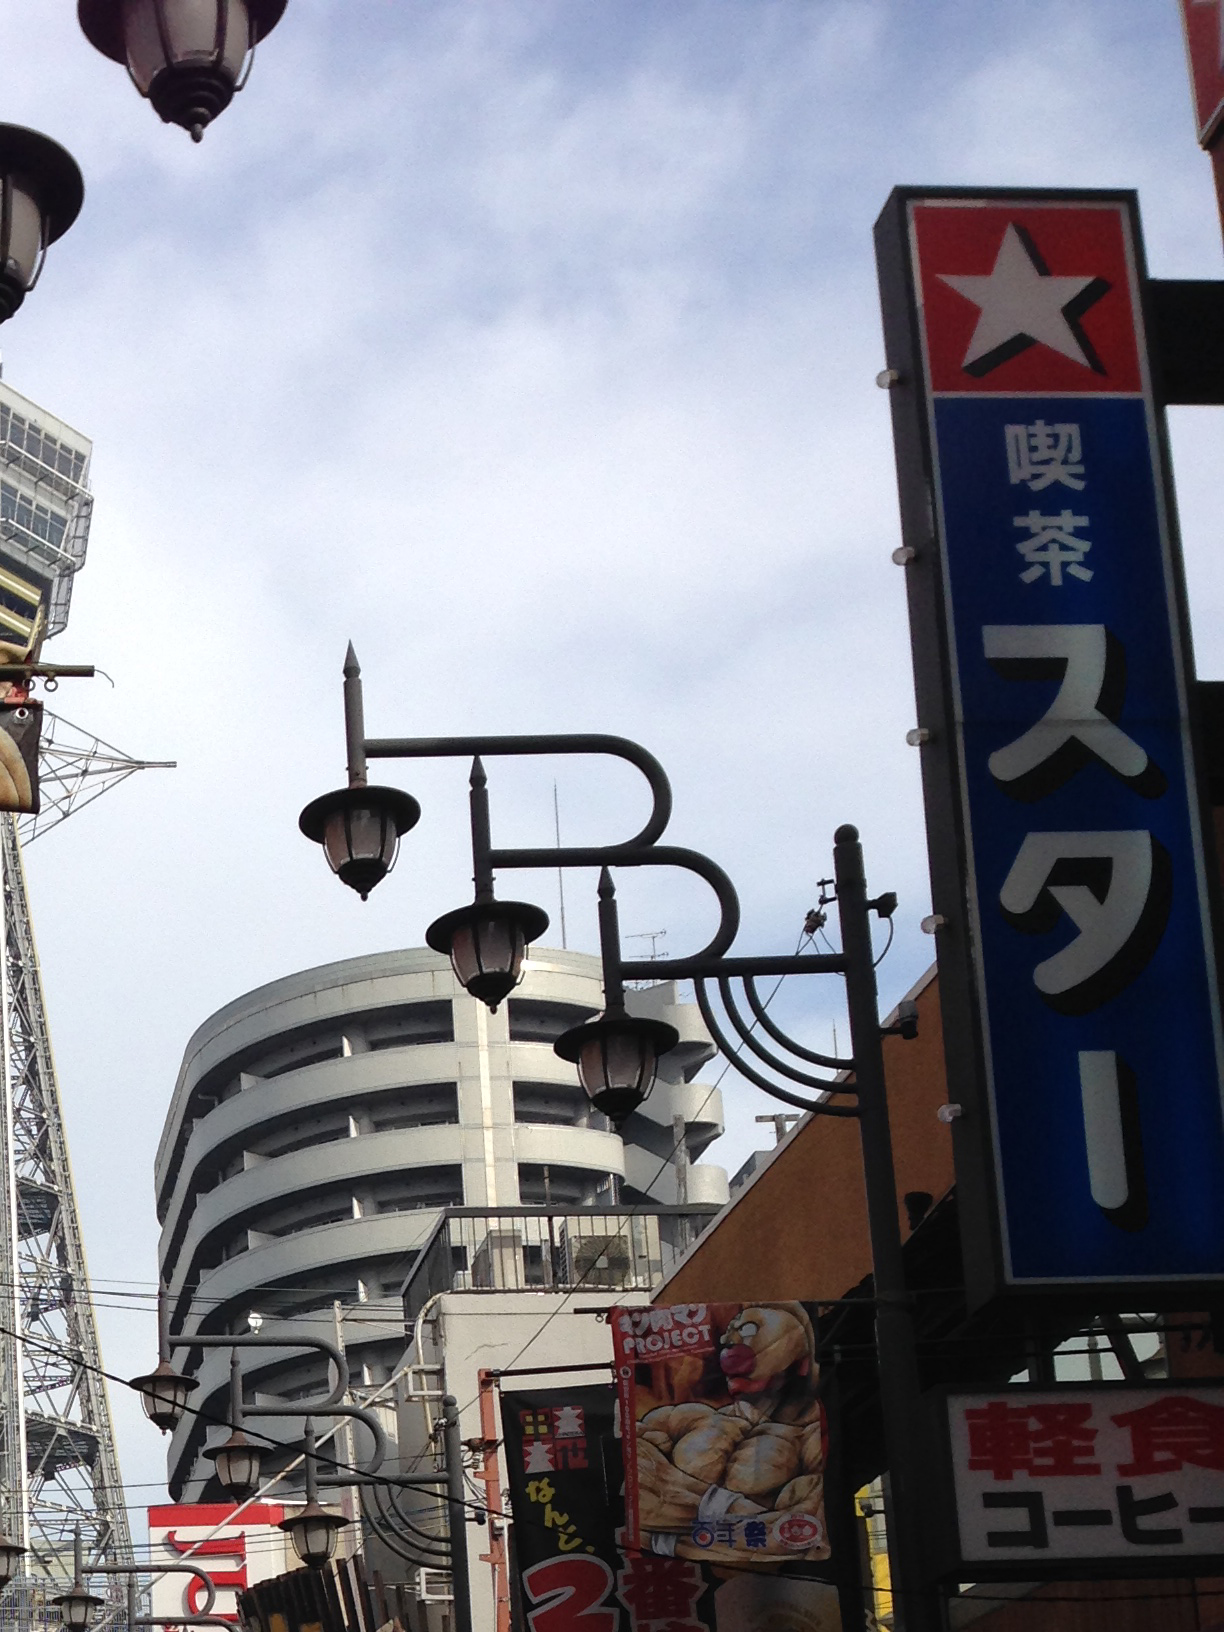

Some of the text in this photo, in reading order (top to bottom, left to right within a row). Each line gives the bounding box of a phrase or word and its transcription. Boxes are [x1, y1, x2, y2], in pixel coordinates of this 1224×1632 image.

[1005, 420, 1095, 586] 喫茶
[981, 623, 1166, 1220] スター
[623, 1324, 712, 1355] PROJECT
[965, 1396, 1224, 1480] 軽食
